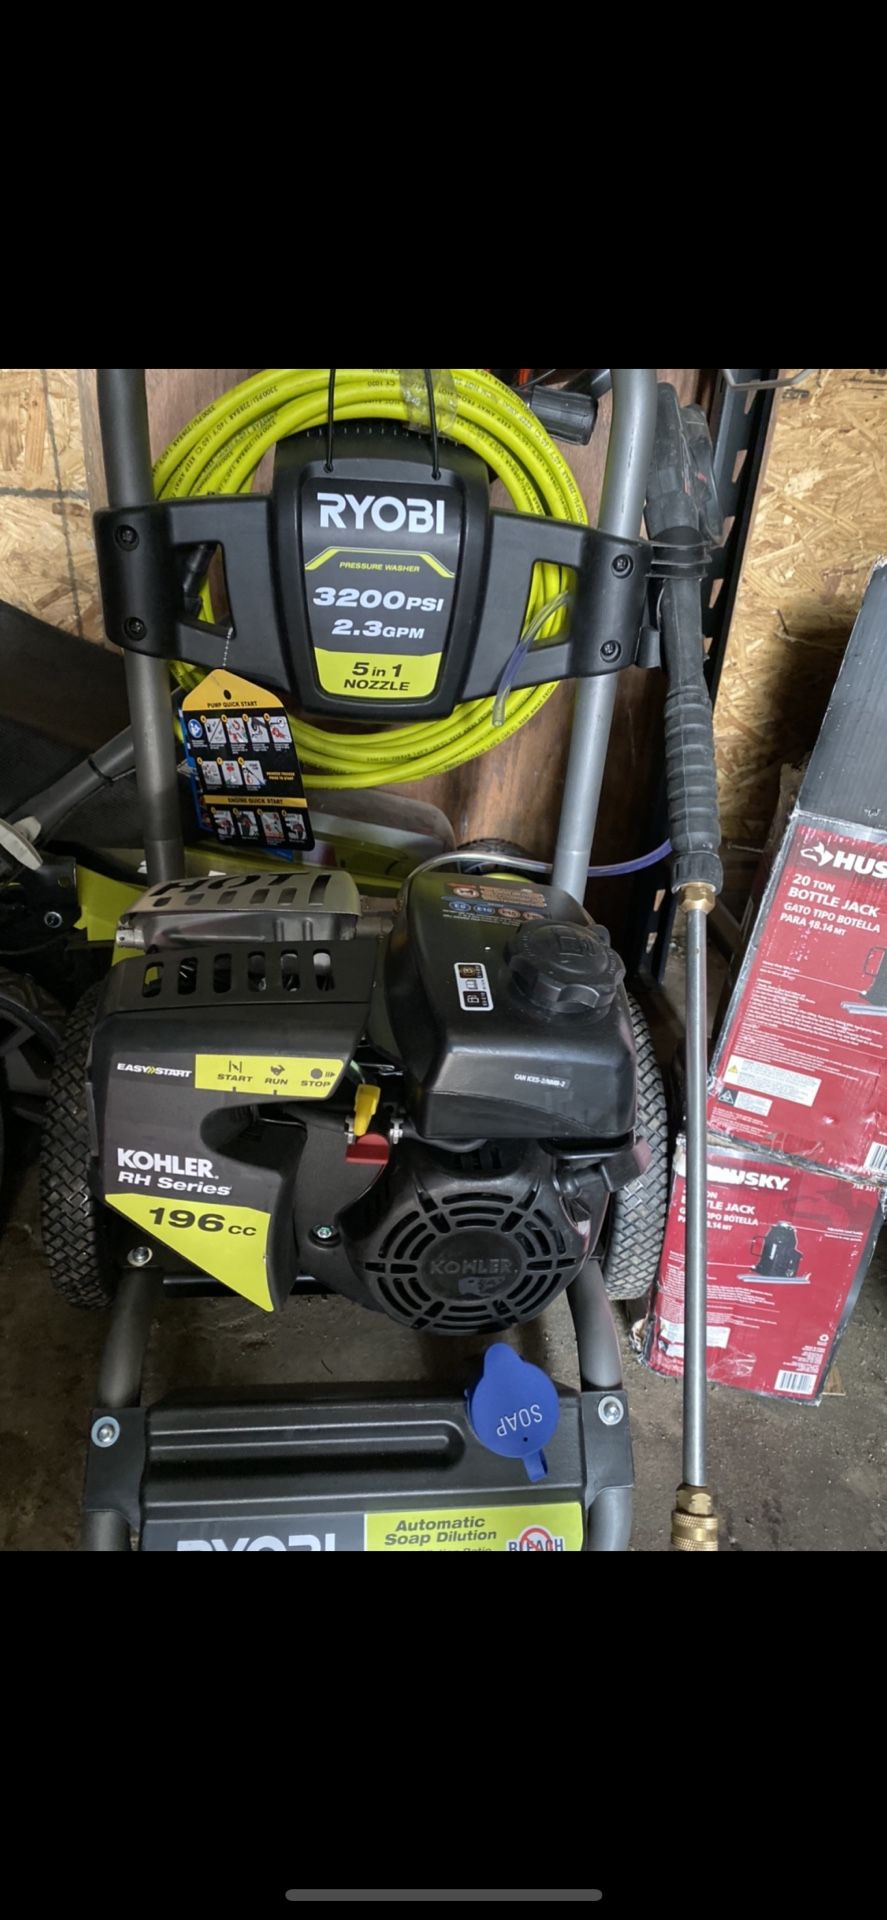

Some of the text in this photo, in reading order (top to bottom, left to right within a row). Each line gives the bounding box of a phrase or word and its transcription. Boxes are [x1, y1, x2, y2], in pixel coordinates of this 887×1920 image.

[317, 492, 445, 534] RYOBI
[339, 562, 420, 573] PRESSURE WASHER
[352, 662, 403, 678] 5 in 1
[343, 679, 410, 691] NOZZLE
[792, 873, 836, 892] 20 TON
[788, 887, 880, 918] BOTTLE JACK
[779, 913, 807, 927] PARA
[809, 919, 833, 932] 18.14
[783, 902, 881, 933] GATO TIPO BOTELLA
[117, 1062, 192, 1077] EASY START
[217, 1073, 253, 1082] START
[265, 1077, 288, 1085] RUN
[118, 1171, 231, 1195] RH Series
[725, 1202, 756, 1214] JACK
[149, 1207, 225, 1232] 196
[723, 1213, 759, 1226] BOTELLA
[496, 1404, 543, 1437] SOAP
[395, 1516, 485, 1532] Automatic
[384, 1531, 497, 1546] Soap Dilution
